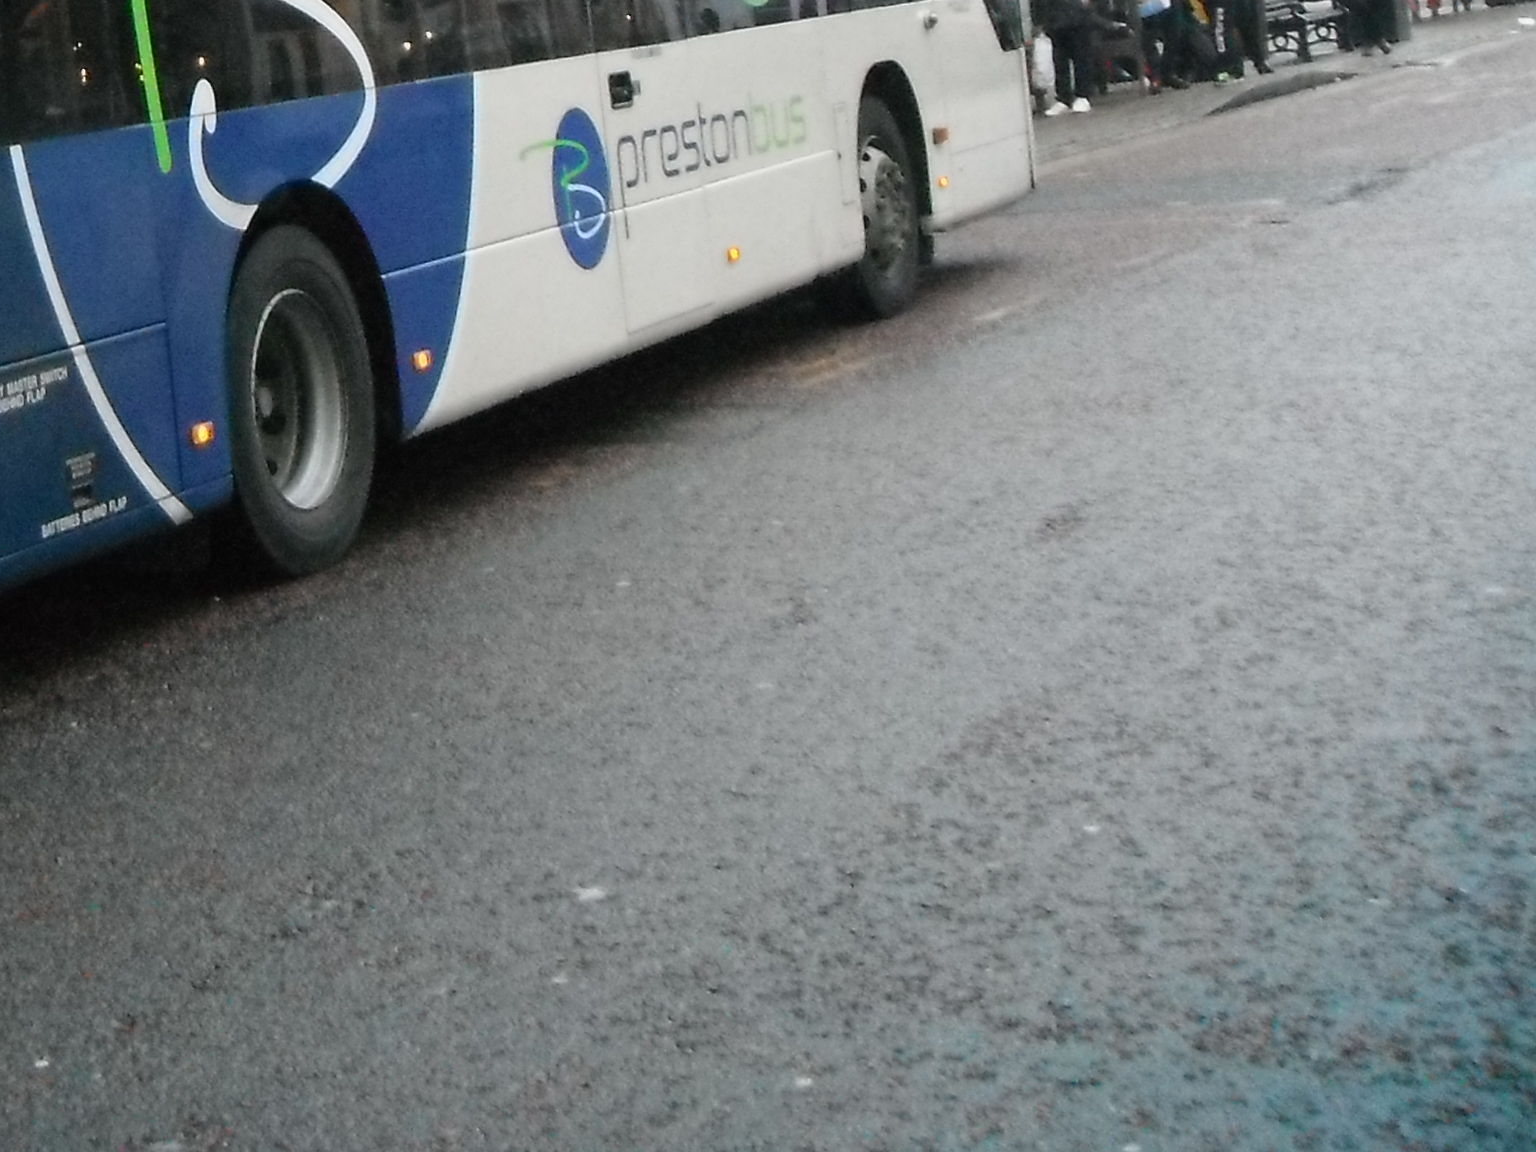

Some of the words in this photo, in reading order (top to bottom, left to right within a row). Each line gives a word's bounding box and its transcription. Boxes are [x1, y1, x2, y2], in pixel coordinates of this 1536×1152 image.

[617, 93, 808, 240] prestonbus
[6, 374, 37, 395] MASTER
[26, 387, 47, 404] FLAP
